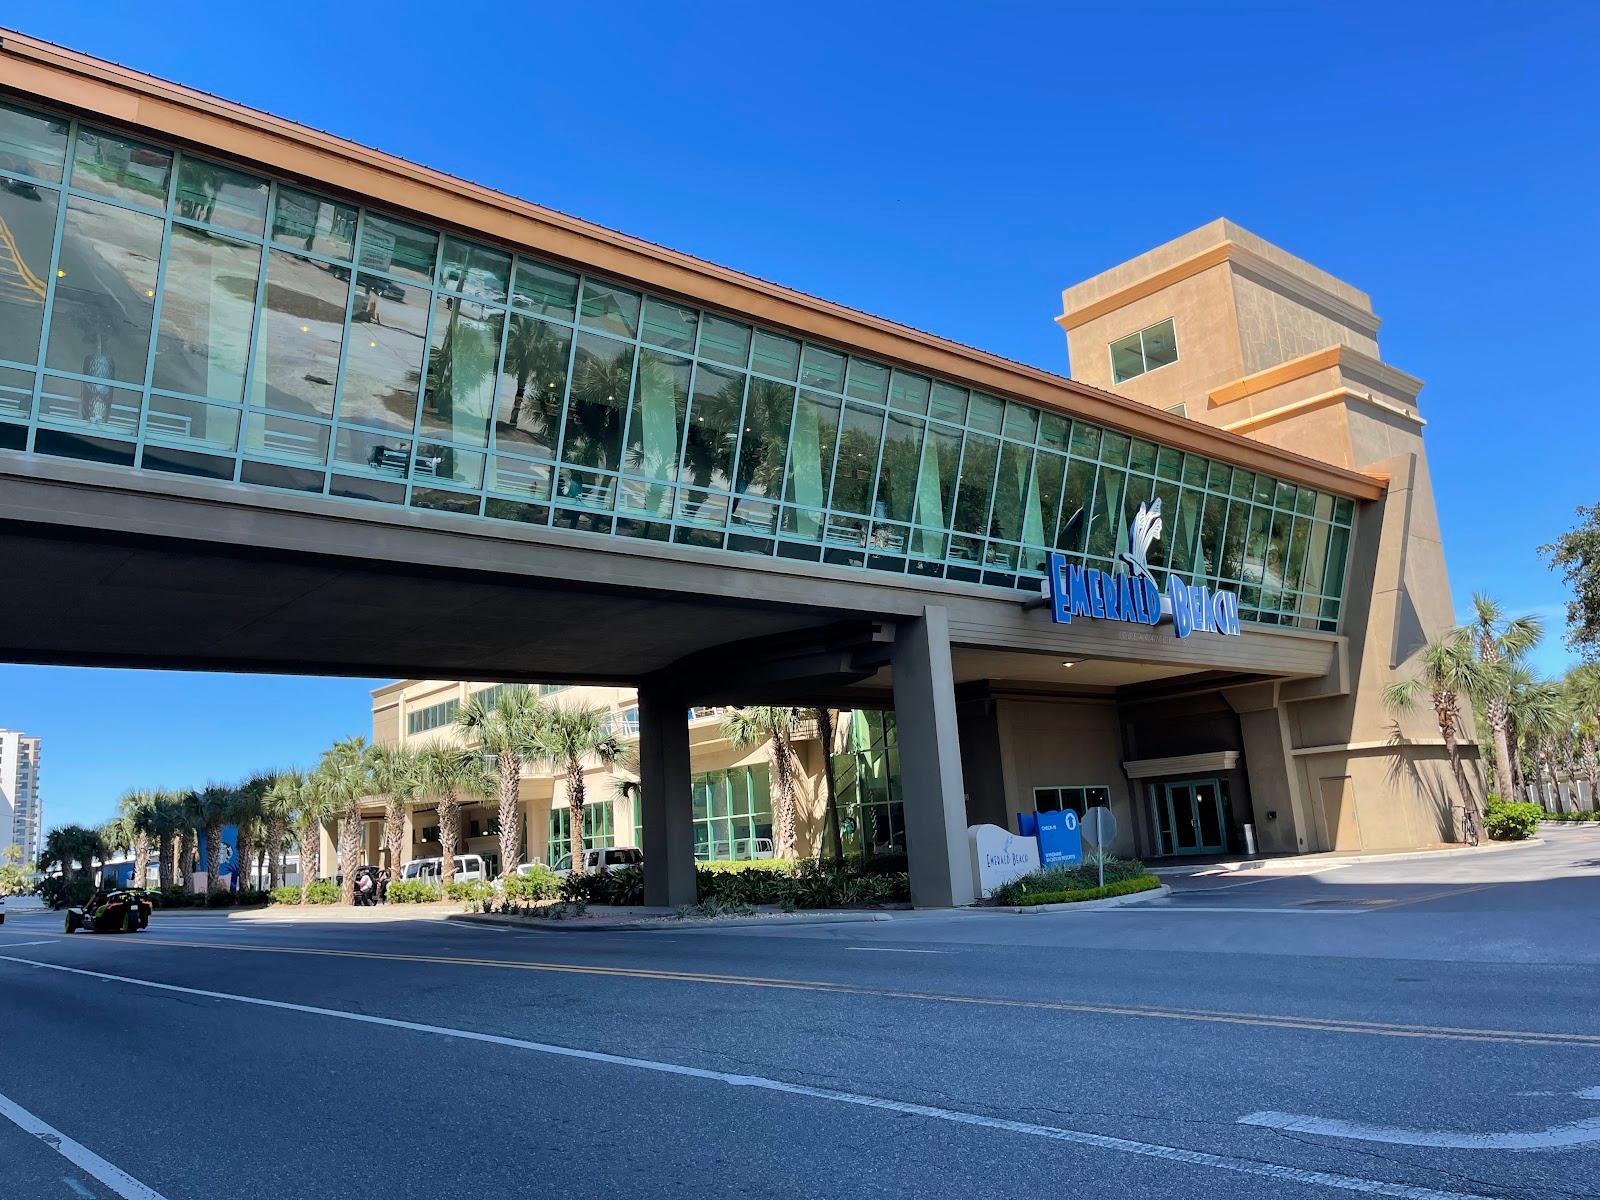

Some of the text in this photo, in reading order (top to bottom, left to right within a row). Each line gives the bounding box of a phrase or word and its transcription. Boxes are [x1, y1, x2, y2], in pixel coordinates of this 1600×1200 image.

[1049, 553, 1241, 638] EMERALD BEACH
[986, 853, 1010, 868] EMERALD
[1012, 853, 1029, 866] BEACH
